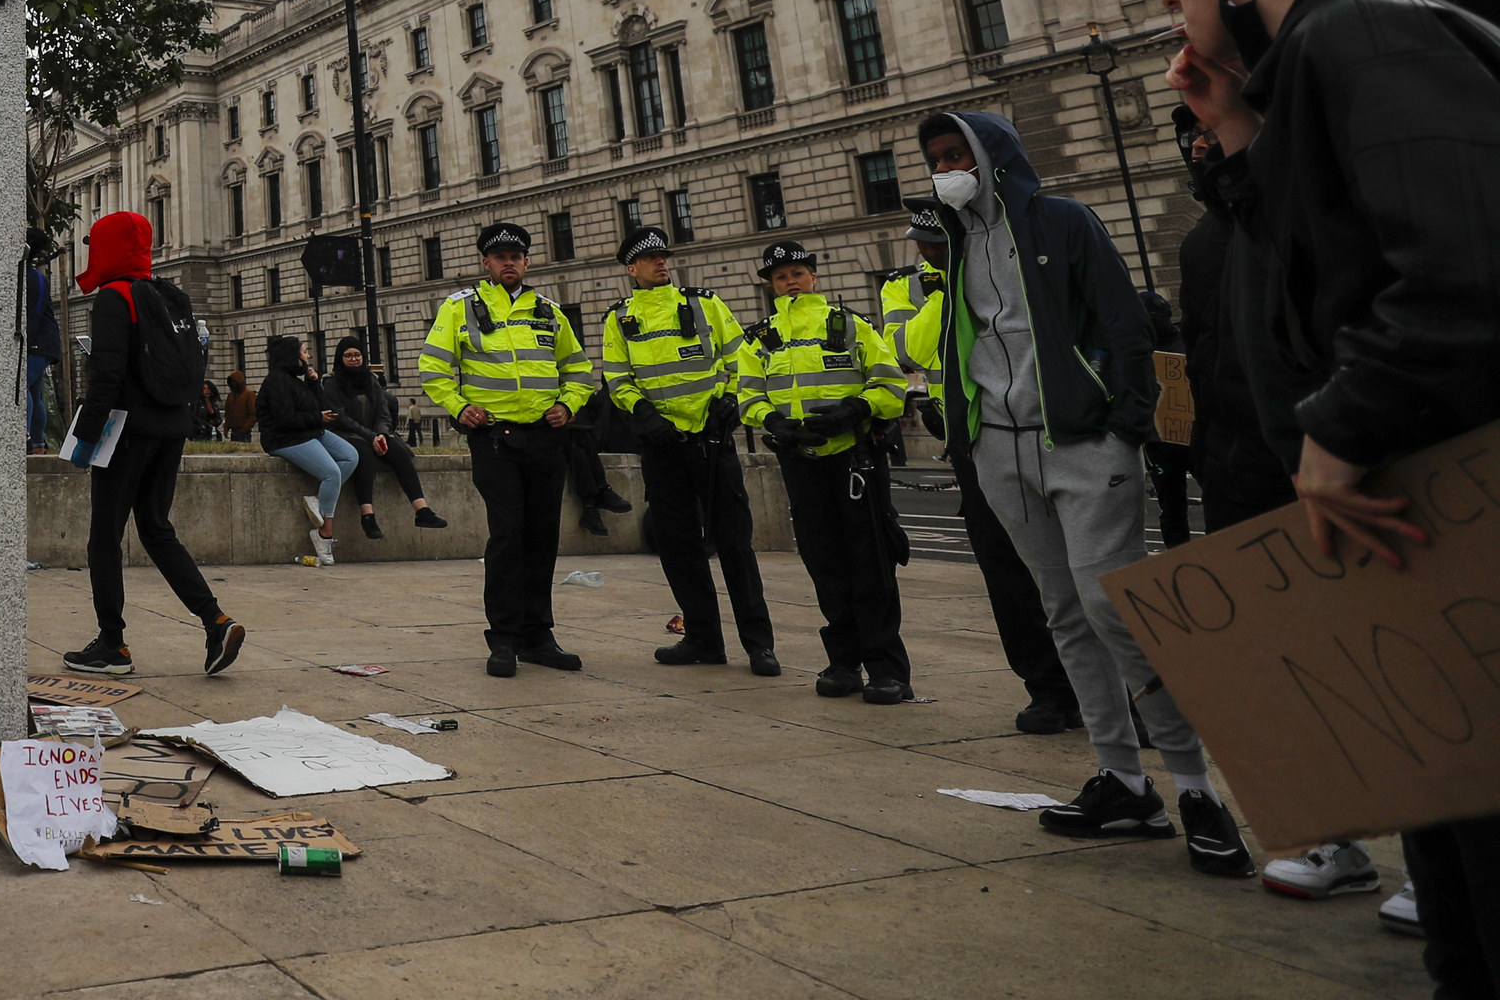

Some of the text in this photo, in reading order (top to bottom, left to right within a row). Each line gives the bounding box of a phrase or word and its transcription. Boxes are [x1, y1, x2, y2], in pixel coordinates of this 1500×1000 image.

[1124, 562, 1236, 647] NO
[1281, 622, 1474, 793] NO
[22, 745, 102, 767] IGNORA
[53, 766, 99, 790] ENDS
[231, 822, 335, 841] LIVES
[59, 839, 83, 849] MATTE
